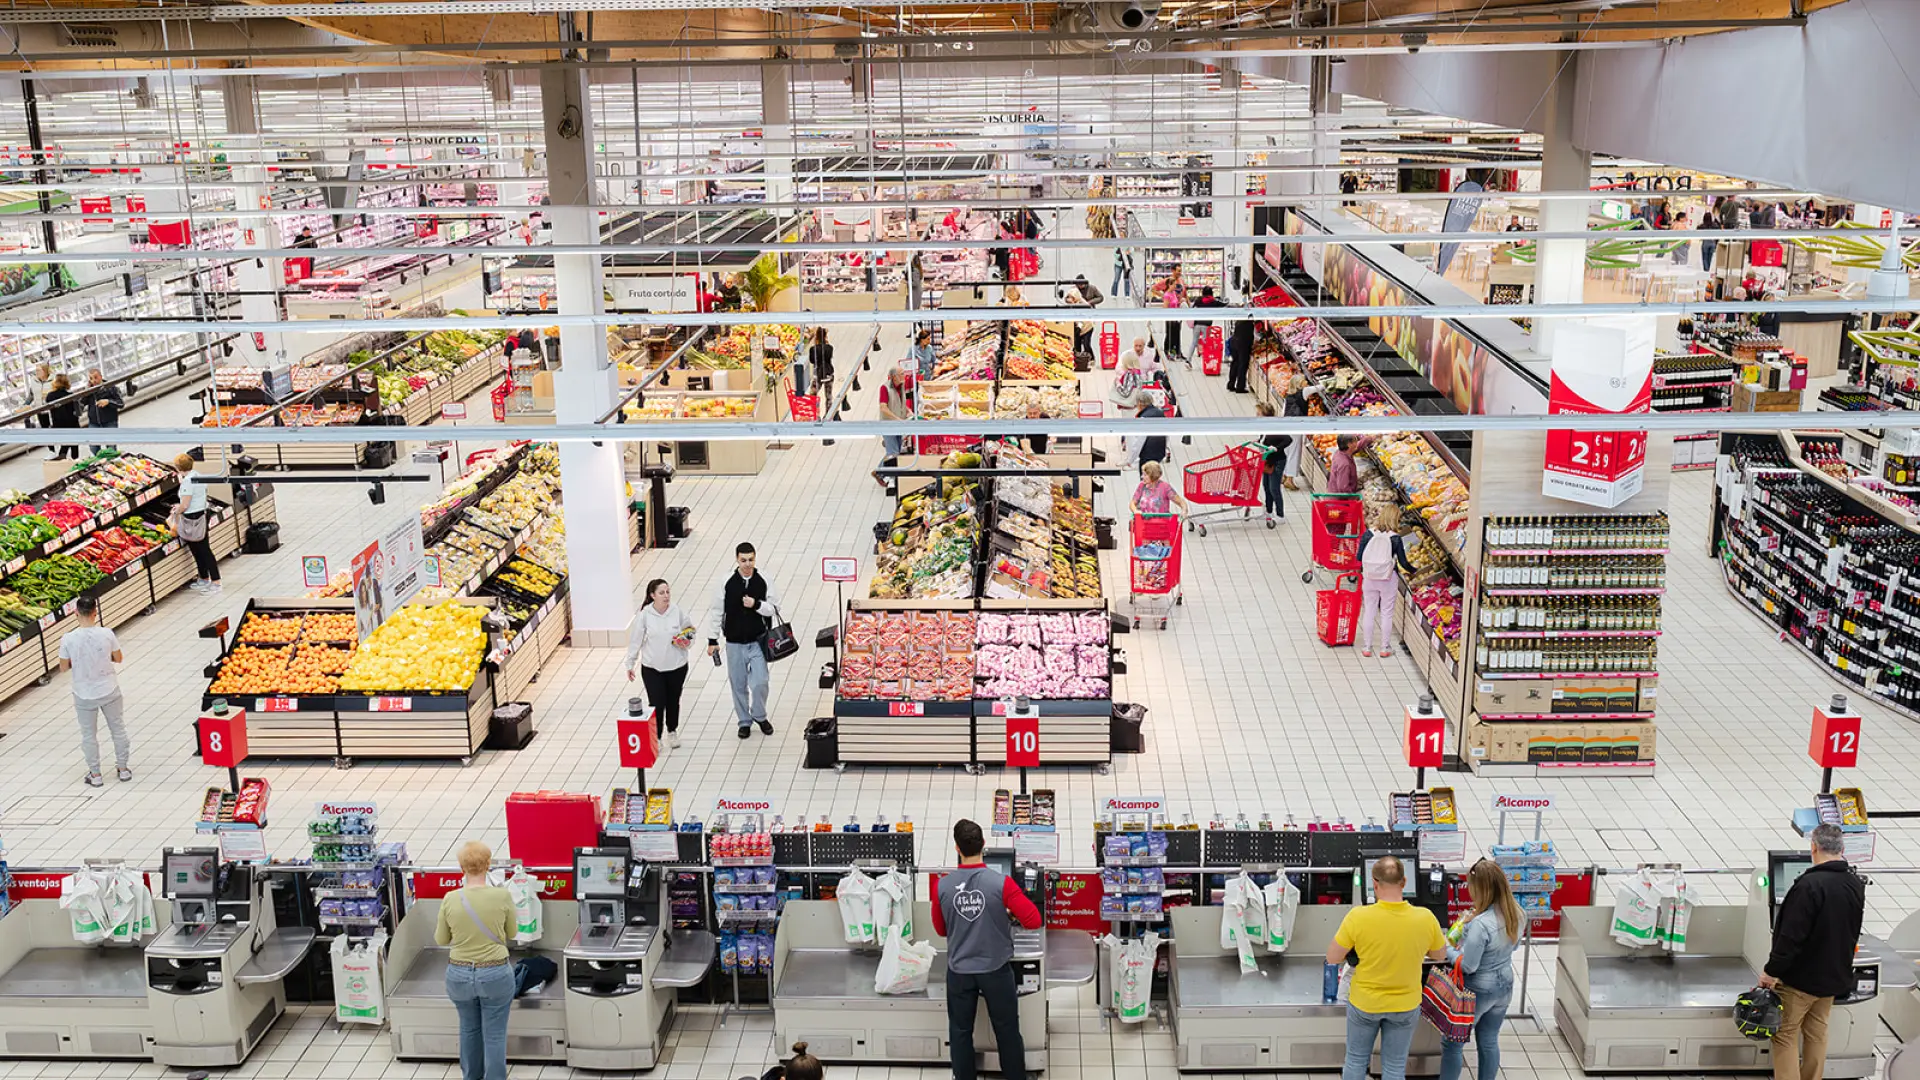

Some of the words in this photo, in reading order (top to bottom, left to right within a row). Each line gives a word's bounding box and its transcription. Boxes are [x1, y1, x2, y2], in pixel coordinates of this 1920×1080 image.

[628, 289, 652, 298] Fruta
[653, 289, 687, 298] cortada
[209, 731, 223, 753] 8
[628, 733, 641, 755] 9
[1010, 731, 1036, 753] 10
[1415, 731, 1440, 754] 11
[1829, 732, 1855, 753] 12
[321, 803, 374, 815] Alcampo
[716, 798, 770, 811] Alcampo
[1106, 798, 1160, 811] Alcampo
[1495, 796, 1550, 809] Alcampo
[18, 877, 60, 891] ventajas
[439, 877, 457, 887] Las
